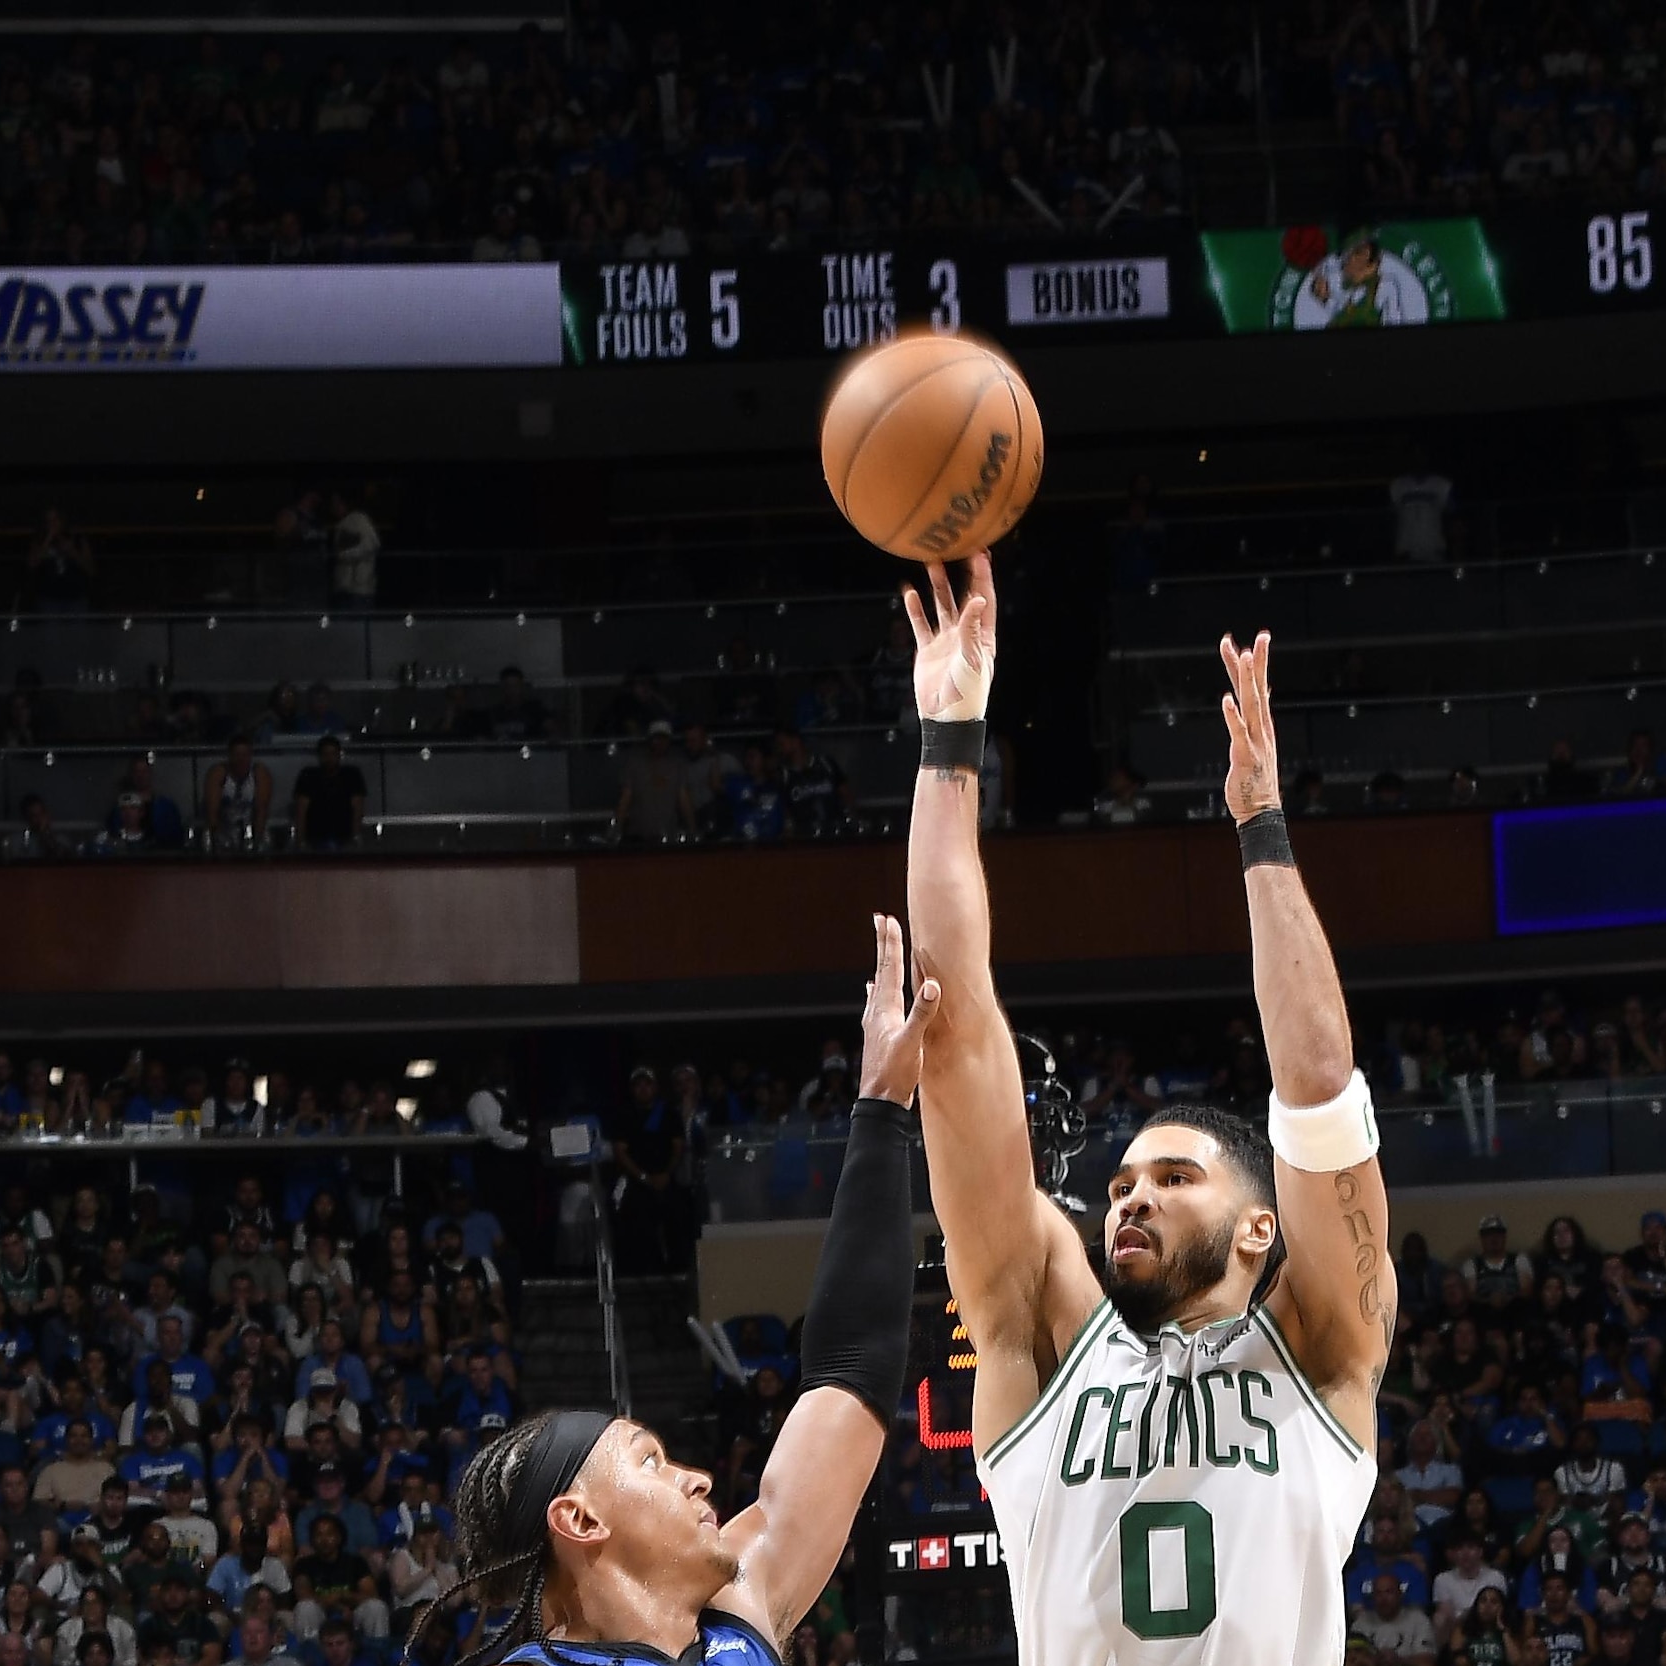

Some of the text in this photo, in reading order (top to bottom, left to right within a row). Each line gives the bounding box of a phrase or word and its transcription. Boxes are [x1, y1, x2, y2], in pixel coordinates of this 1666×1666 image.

[821, 251, 894, 302] TIME
[1587, 212, 1653, 295] 85
[600, 263, 680, 311] TEAM
[709, 269, 742, 350] 5
[928, 258, 963, 336] 3
[1033, 266, 1142, 315] BONUS
[596, 309, 689, 361] FOULS
[823, 302, 899, 350] OUTS
[915, 432, 1012, 552] Wilson
[1058, 1369, 1279, 1488] CELTICS
[953, 1532, 1007, 1568] TI
[1118, 1500, 1218, 1642] 0
